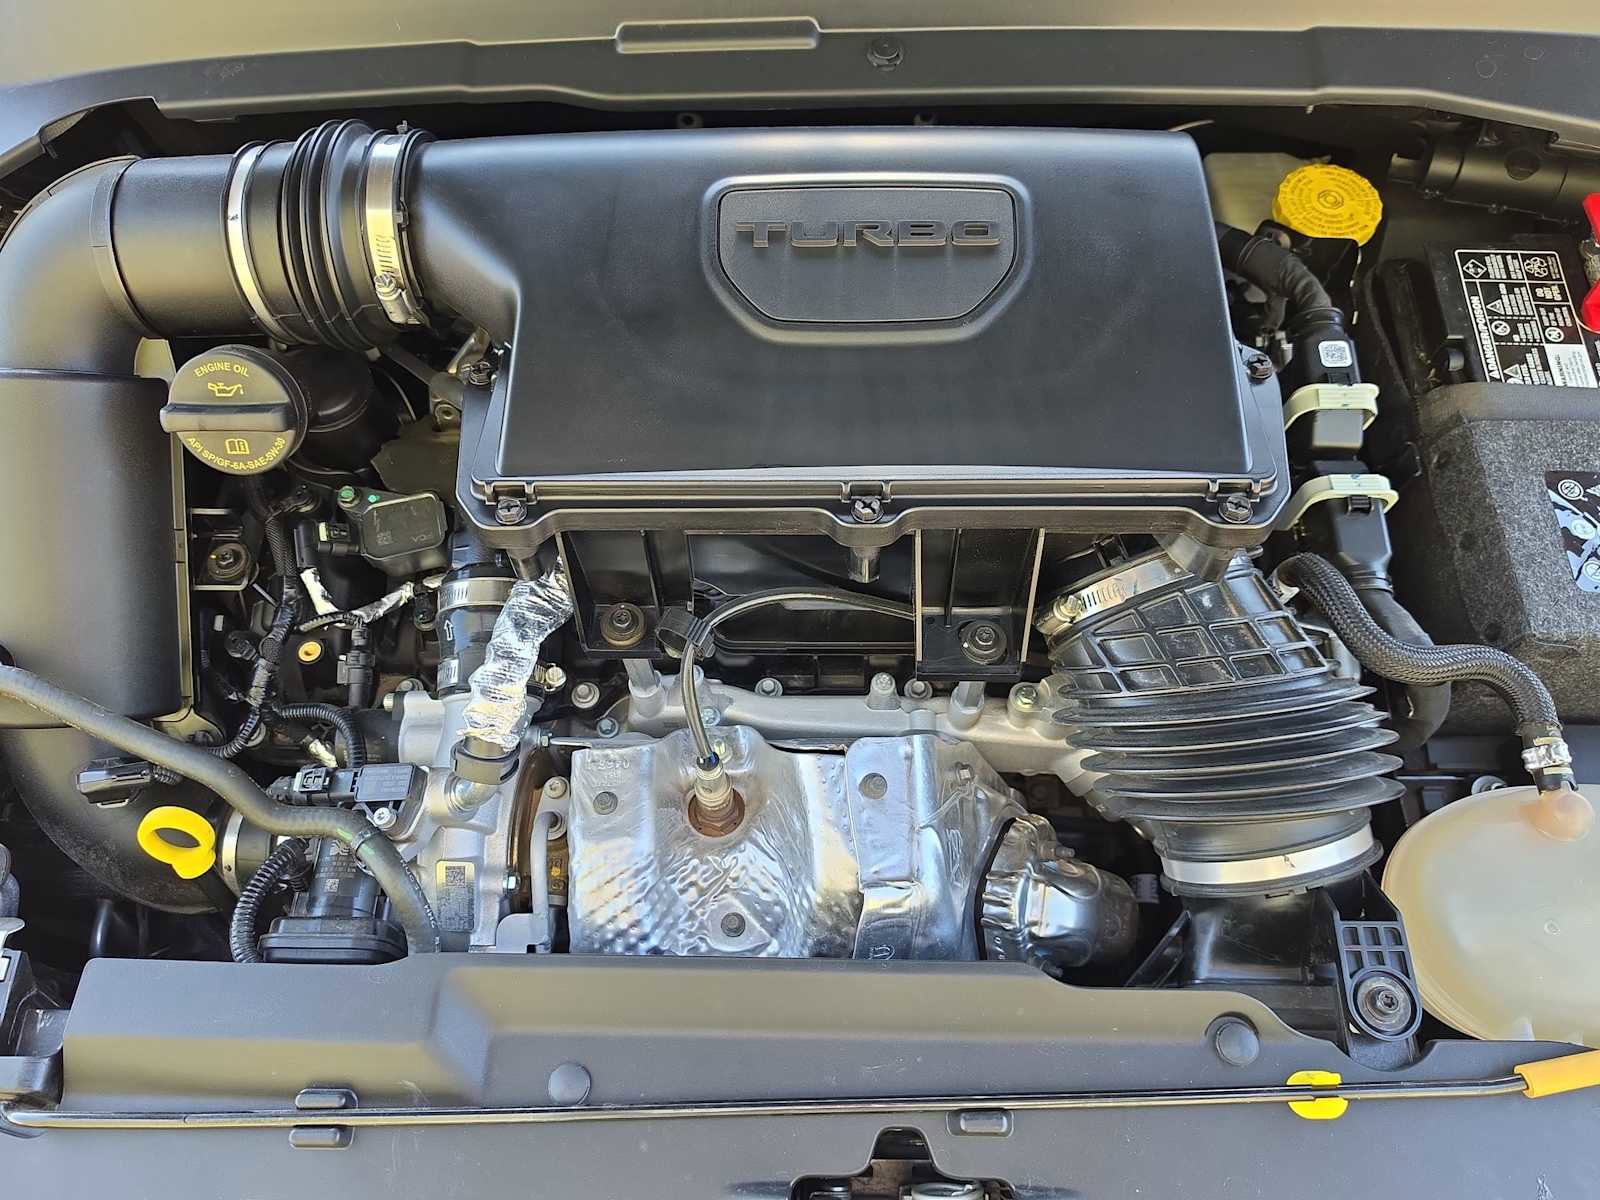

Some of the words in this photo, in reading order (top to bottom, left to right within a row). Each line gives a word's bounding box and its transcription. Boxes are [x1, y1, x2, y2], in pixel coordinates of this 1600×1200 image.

[736, 220, 1001, 248] TURBO
[1470, 295, 1499, 370] DANGER/POISON
[194, 362, 231, 377] ENGINE
[233, 364, 249, 377] OIL
[187, 437, 202, 453] API
